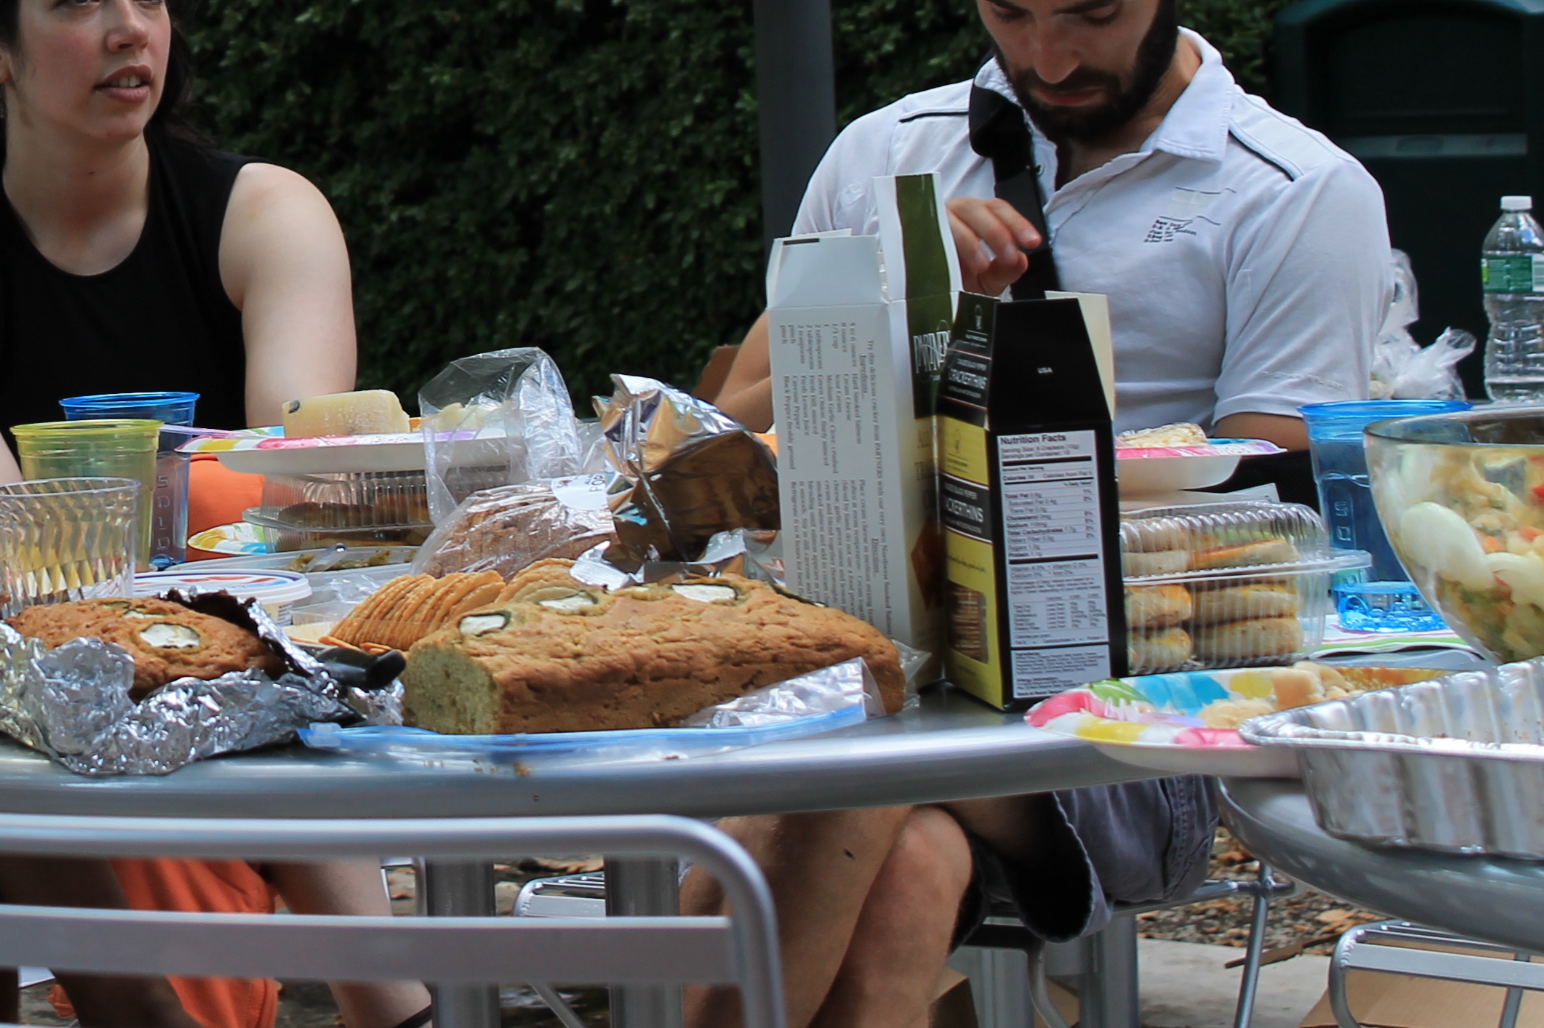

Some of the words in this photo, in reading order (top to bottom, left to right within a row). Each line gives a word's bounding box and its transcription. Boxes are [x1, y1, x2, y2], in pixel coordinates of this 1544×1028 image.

[913, 329, 951, 374] PARTNER
[1000, 435, 1039, 444] Nutrition
[1041, 433, 1065, 442] Facts
